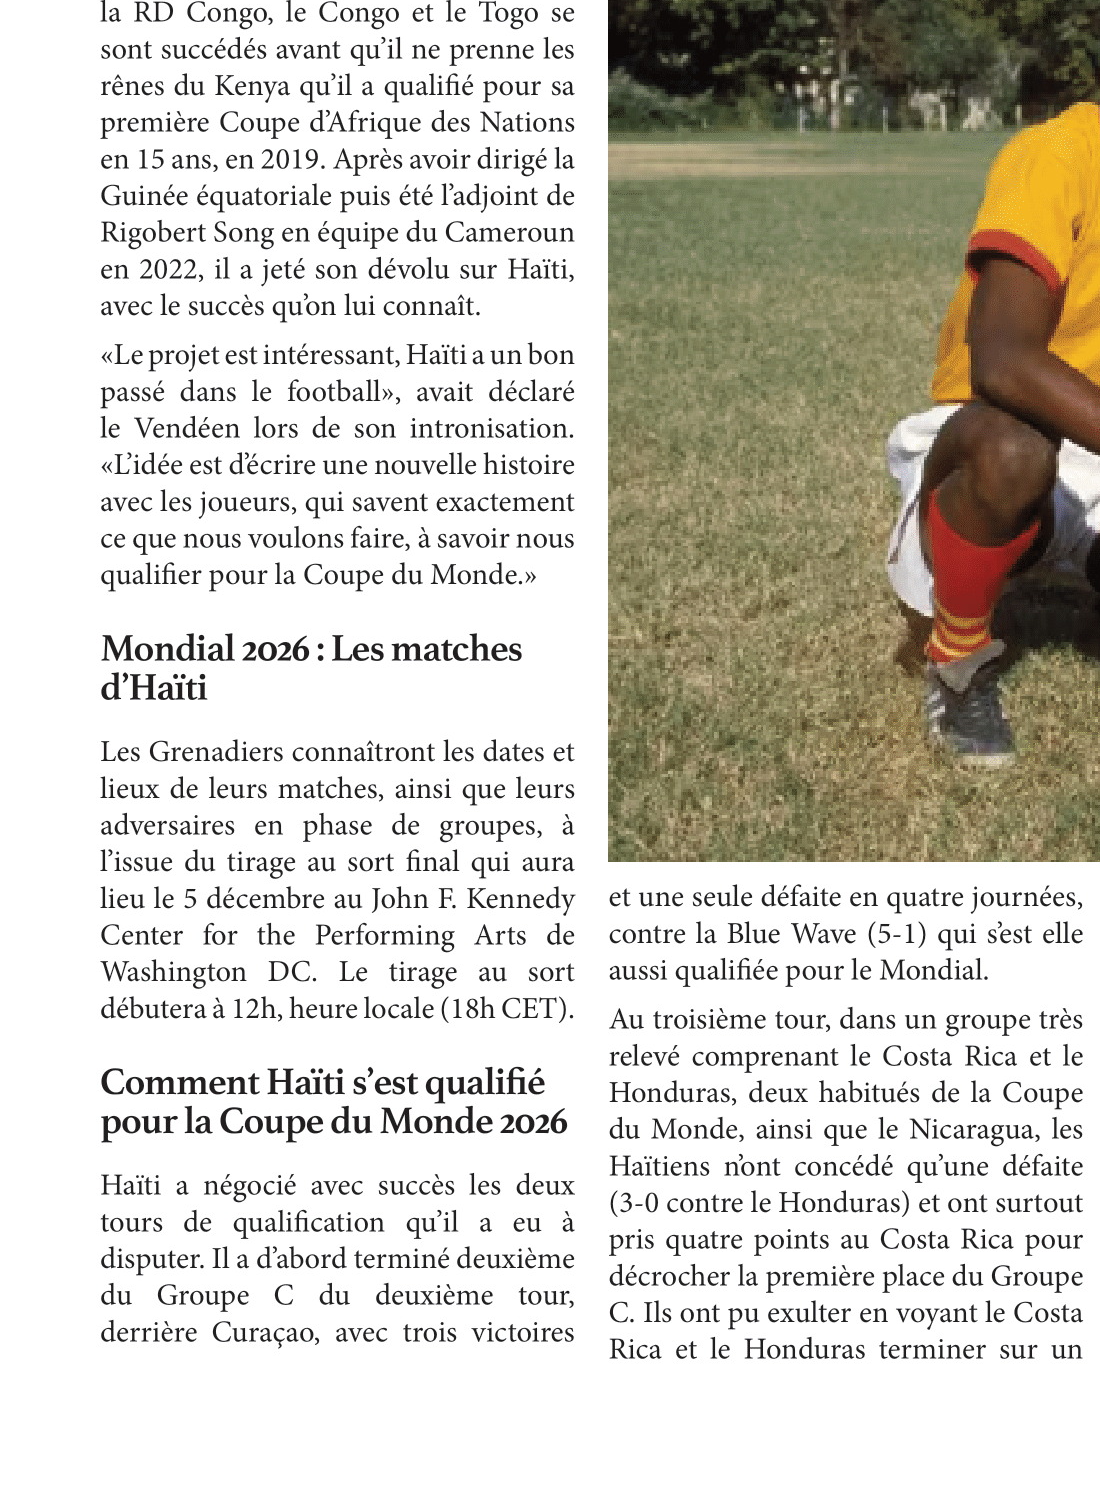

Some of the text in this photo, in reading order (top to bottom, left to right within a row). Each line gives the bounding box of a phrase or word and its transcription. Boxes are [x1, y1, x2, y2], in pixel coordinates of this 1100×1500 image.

[101, 73, 575, 103] rênes du Kenya qu’il a qualifié pour sa
[102, 633, 235, 661] Mondial
[242, 636, 309, 661] 2026
[332, 635, 384, 661] Les
[392, 633, 522, 661] matches
[101, 672, 207, 700] d’Haïti
[610, 921, 1083, 951] contre la Blue Wave (5-1) qui s’est elle
[101, 1067, 545, 1104] Comment Haïti s’est qualifié
[101, 1106, 567, 1143] pour la Coupe du Monde 2026
[101, 1173, 575, 1202] Haïti a négocié avec succès les deux
